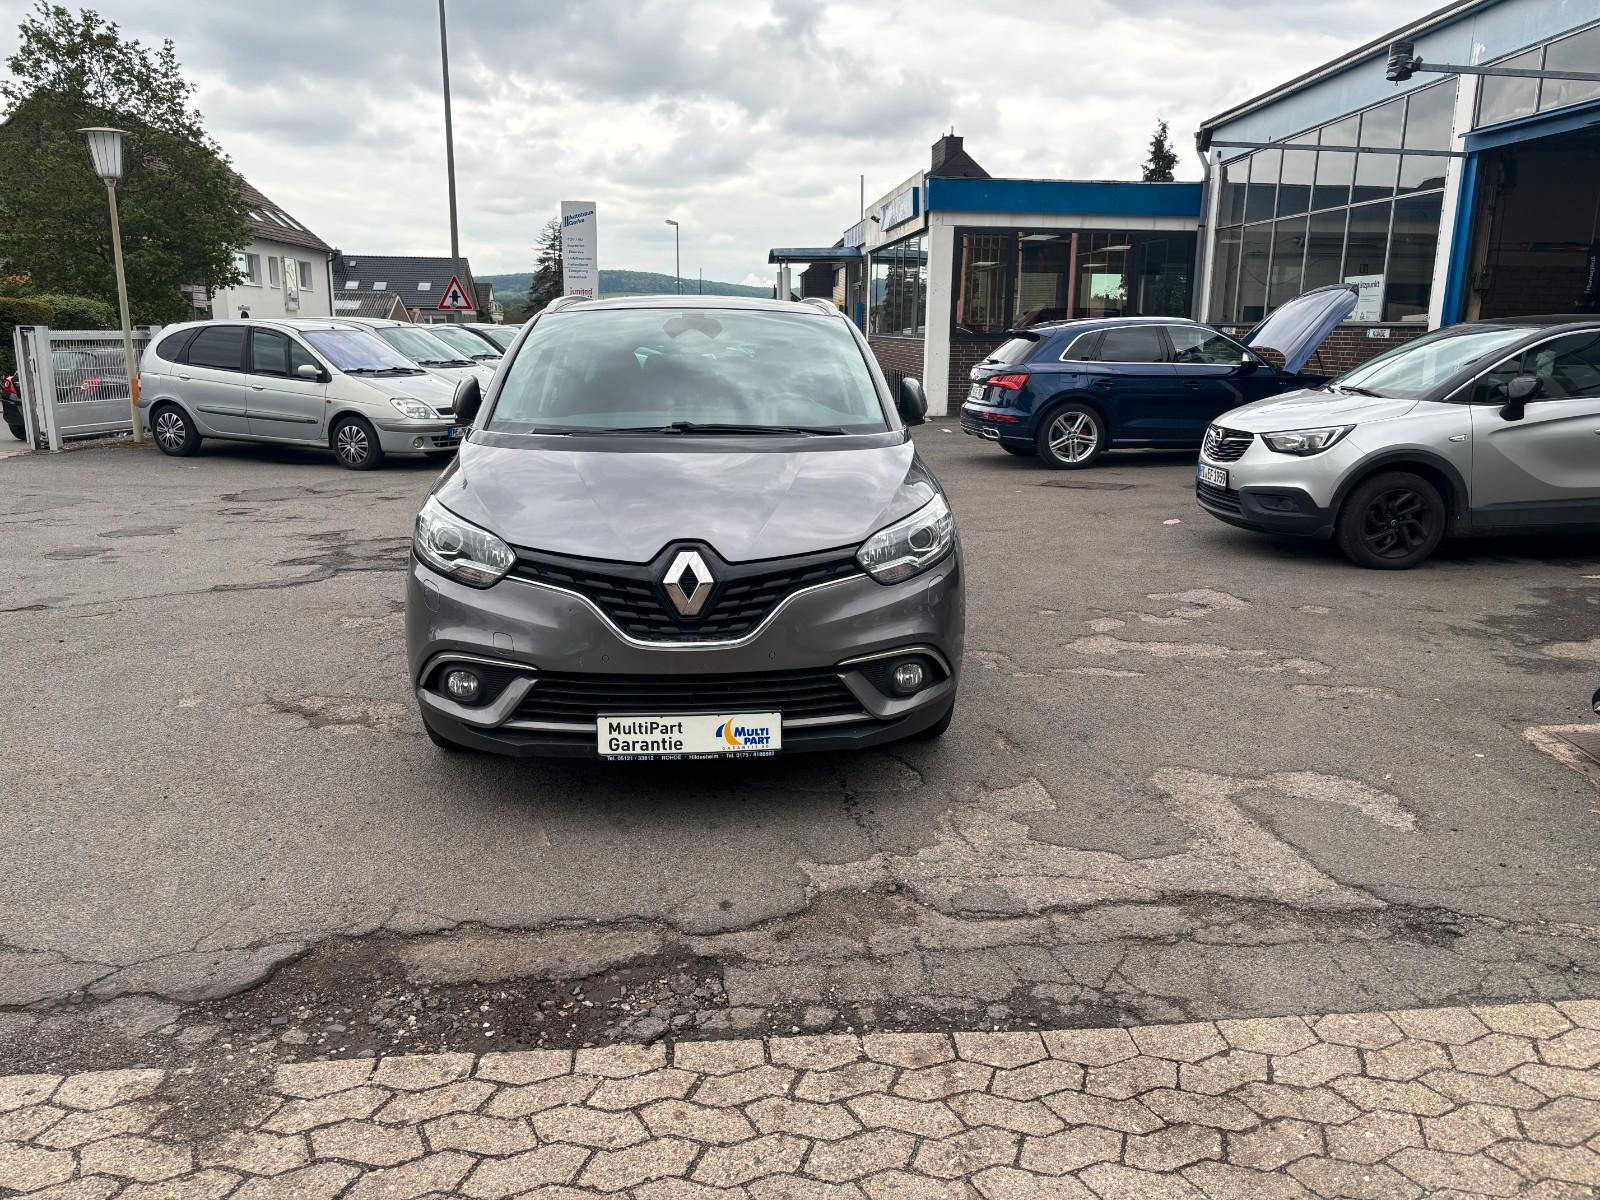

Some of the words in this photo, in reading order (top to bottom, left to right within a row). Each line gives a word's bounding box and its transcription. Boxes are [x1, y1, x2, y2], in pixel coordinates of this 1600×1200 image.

[608, 721, 683, 735] MultiPart
[733, 727, 769, 737] MULTI
[608, 737, 684, 752] Garantie
[744, 736, 771, 745] PART
